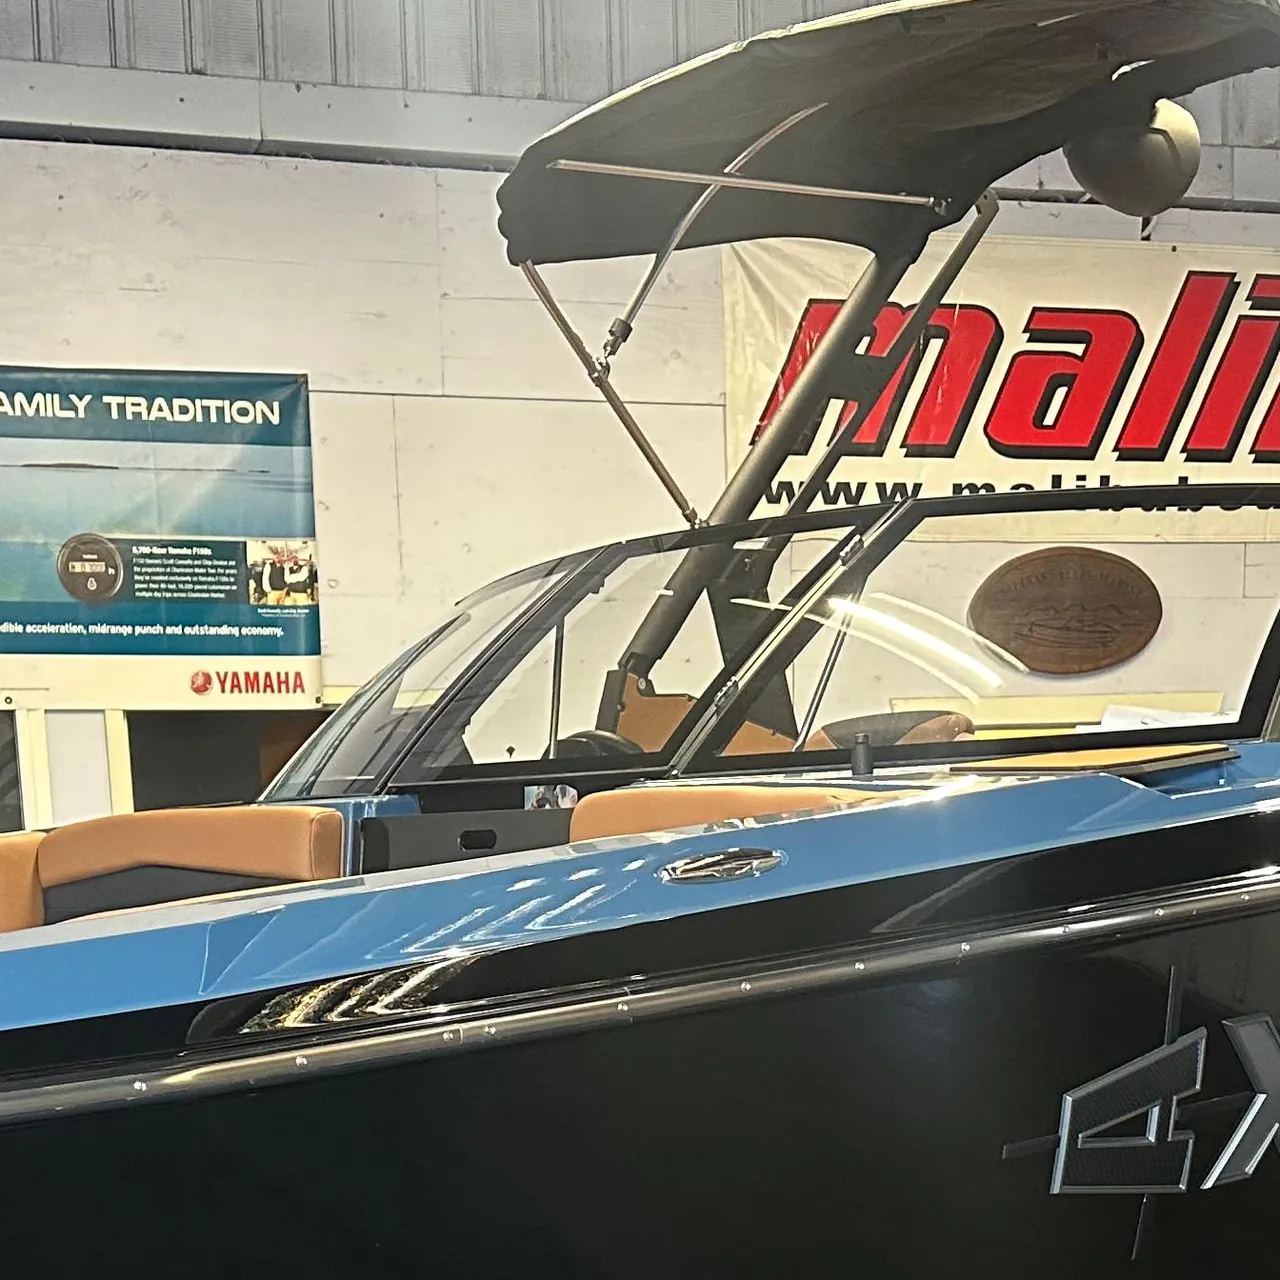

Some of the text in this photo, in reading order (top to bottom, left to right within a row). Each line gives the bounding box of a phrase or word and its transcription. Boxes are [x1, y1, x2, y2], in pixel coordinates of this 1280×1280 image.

[102, 395, 280, 426] TRADITION
[25, 622, 87, 636] acceleration,
[89, 623, 133, 637] midrange
[135, 624, 164, 637] punch
[166, 624, 182, 636] and
[184, 625, 239, 638] outstanding
[241, 627, 284, 638] economy.
[215, 671, 306, 694] YAMAHA
